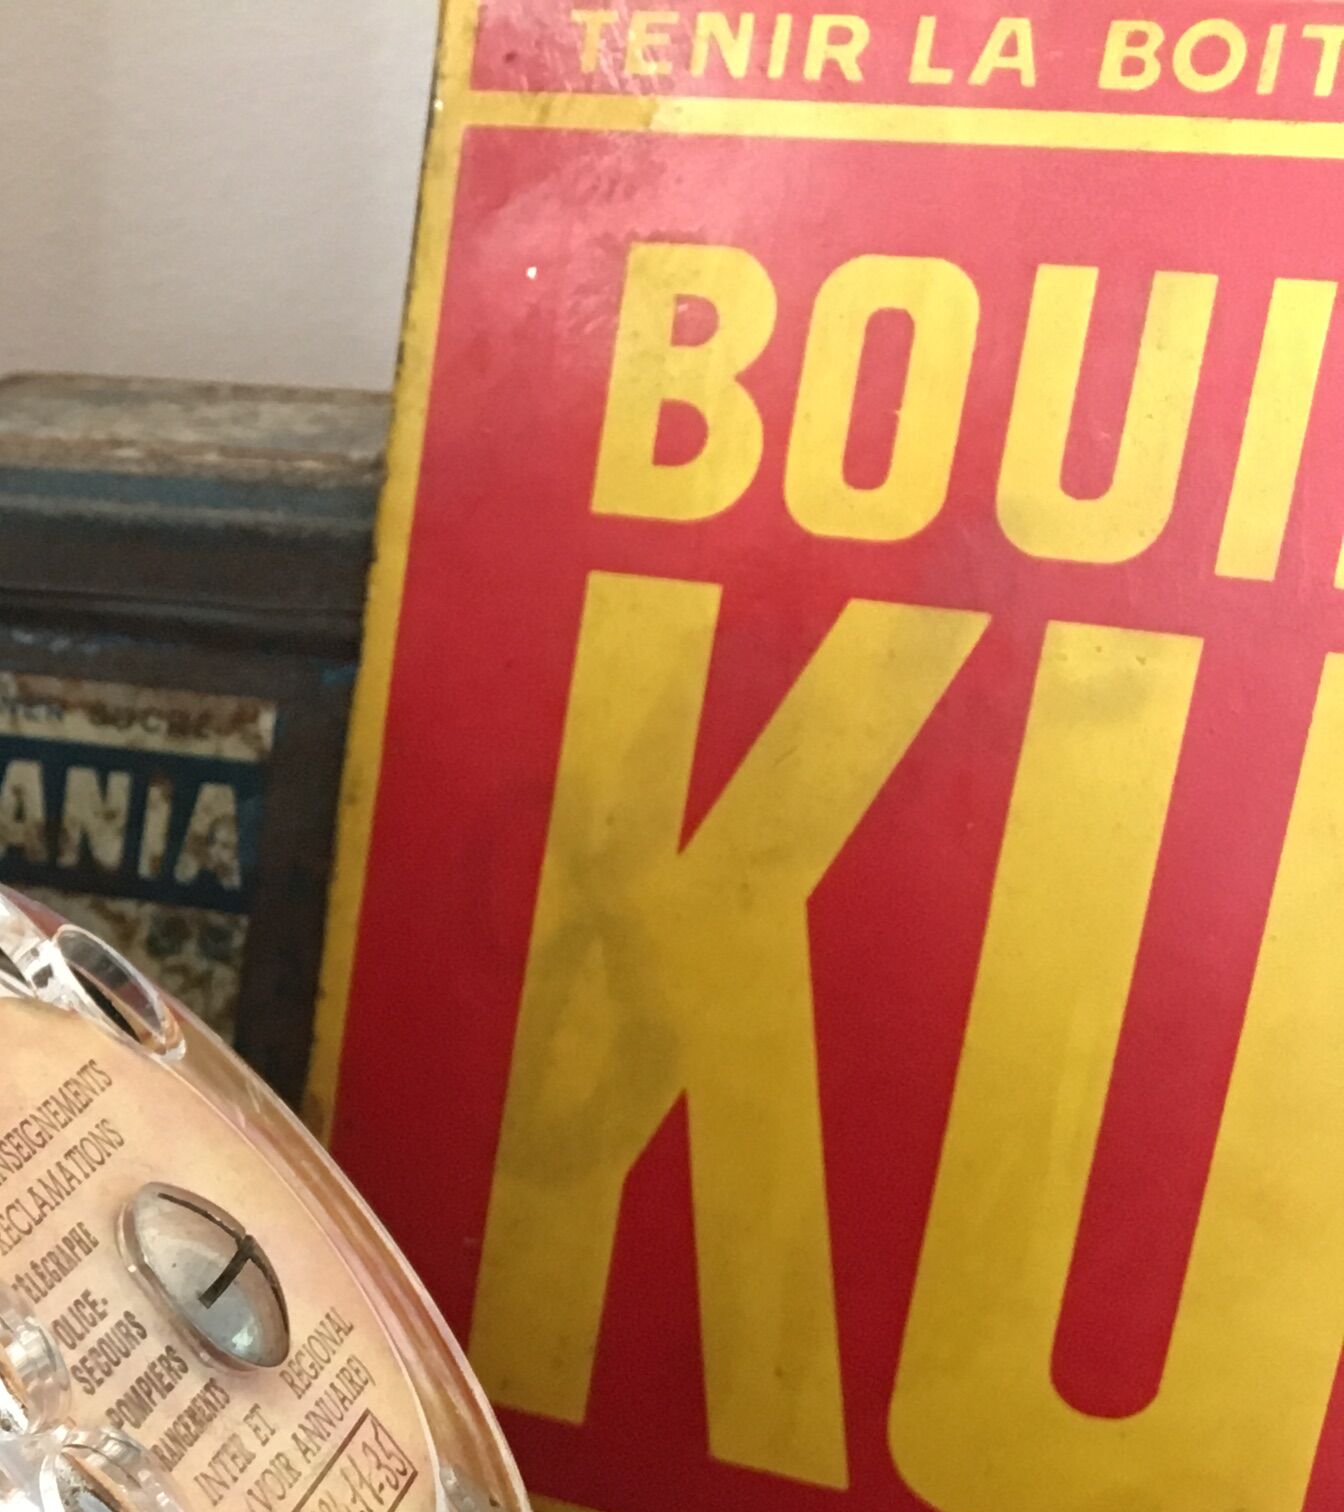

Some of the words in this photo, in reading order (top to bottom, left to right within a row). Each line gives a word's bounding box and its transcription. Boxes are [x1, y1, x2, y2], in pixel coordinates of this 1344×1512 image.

[572, 8, 871, 82] TENIR
[909, 15, 1036, 87] LA
[1098, 17, 1344, 97] BOIT
[591, 242, 1344, 591] BOUI
[70, 1310, 148, 1396] SECOURS
[105, 1344, 189, 1429] POMPIERS
[193, 1432, 256, 1507] INTER
[243, 1402, 276, 1447] ET
